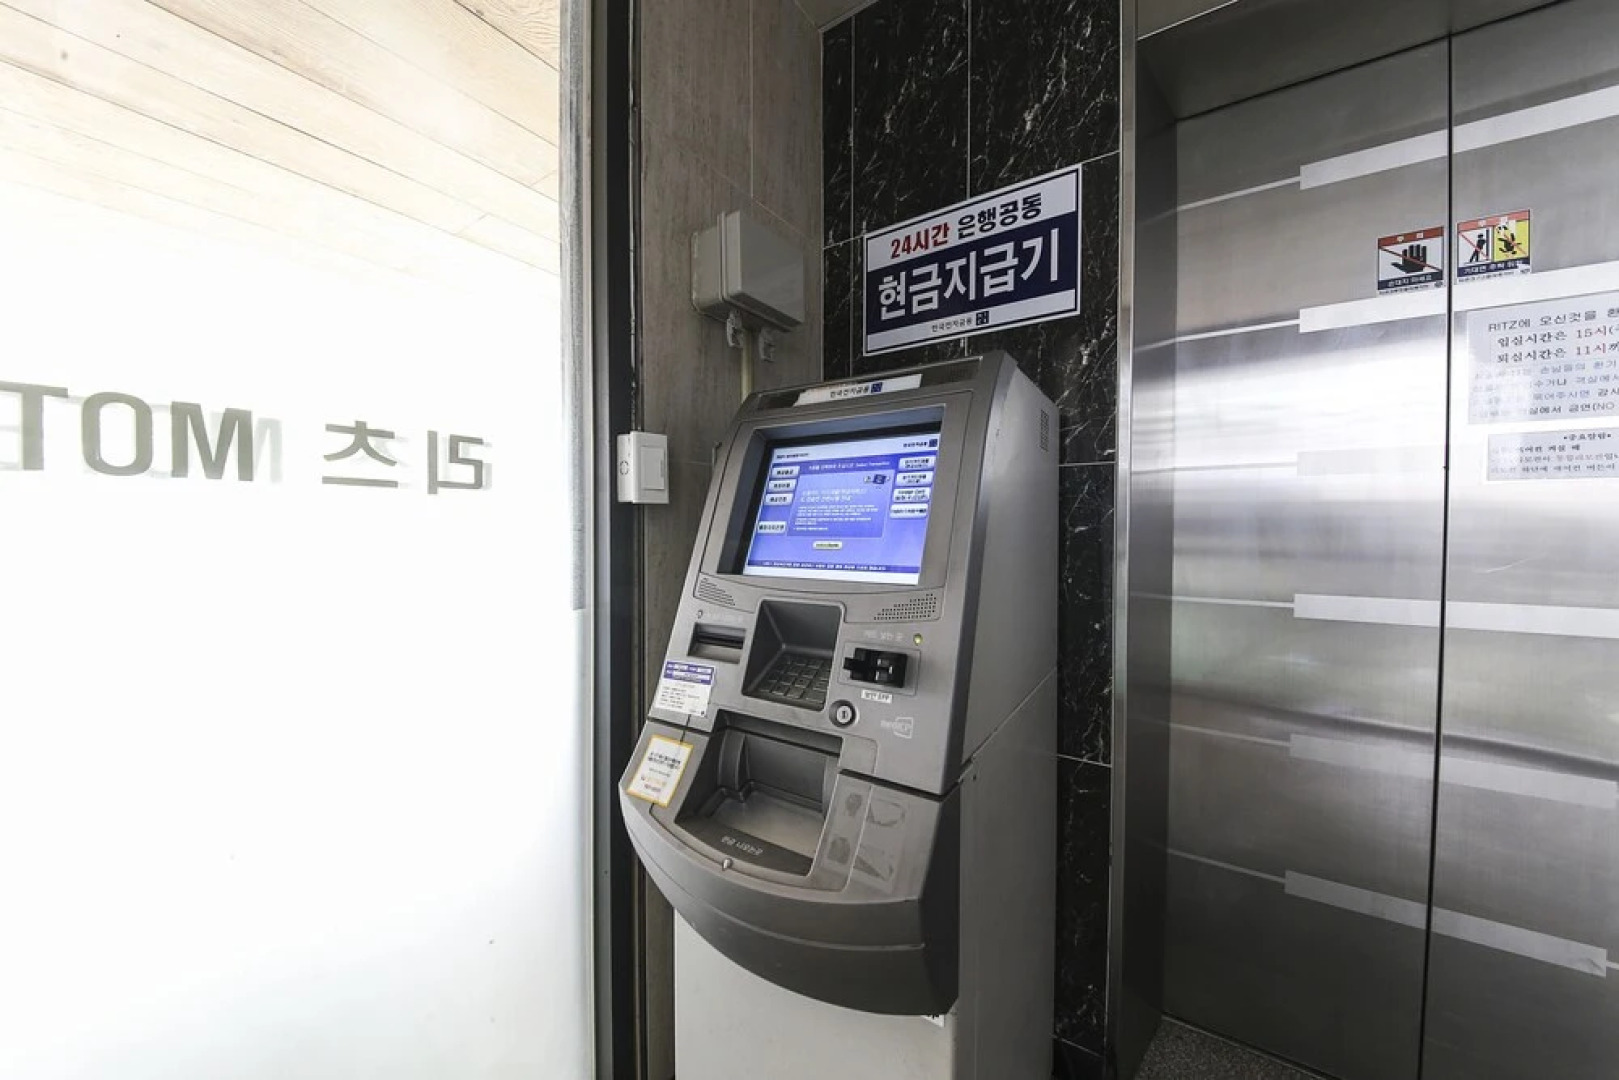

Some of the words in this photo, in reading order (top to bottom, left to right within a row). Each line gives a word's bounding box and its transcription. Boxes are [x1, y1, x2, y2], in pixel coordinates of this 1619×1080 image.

[890, 222, 950, 260] 24시간
[957, 192, 1042, 240] 은행공동
[878, 227, 1059, 321] 현금지급기
[1488, 318, 1531, 332] RITZ에
[1498, 330, 1567, 347] 입실시간은
[1576, 324, 1619, 339] 15시(
